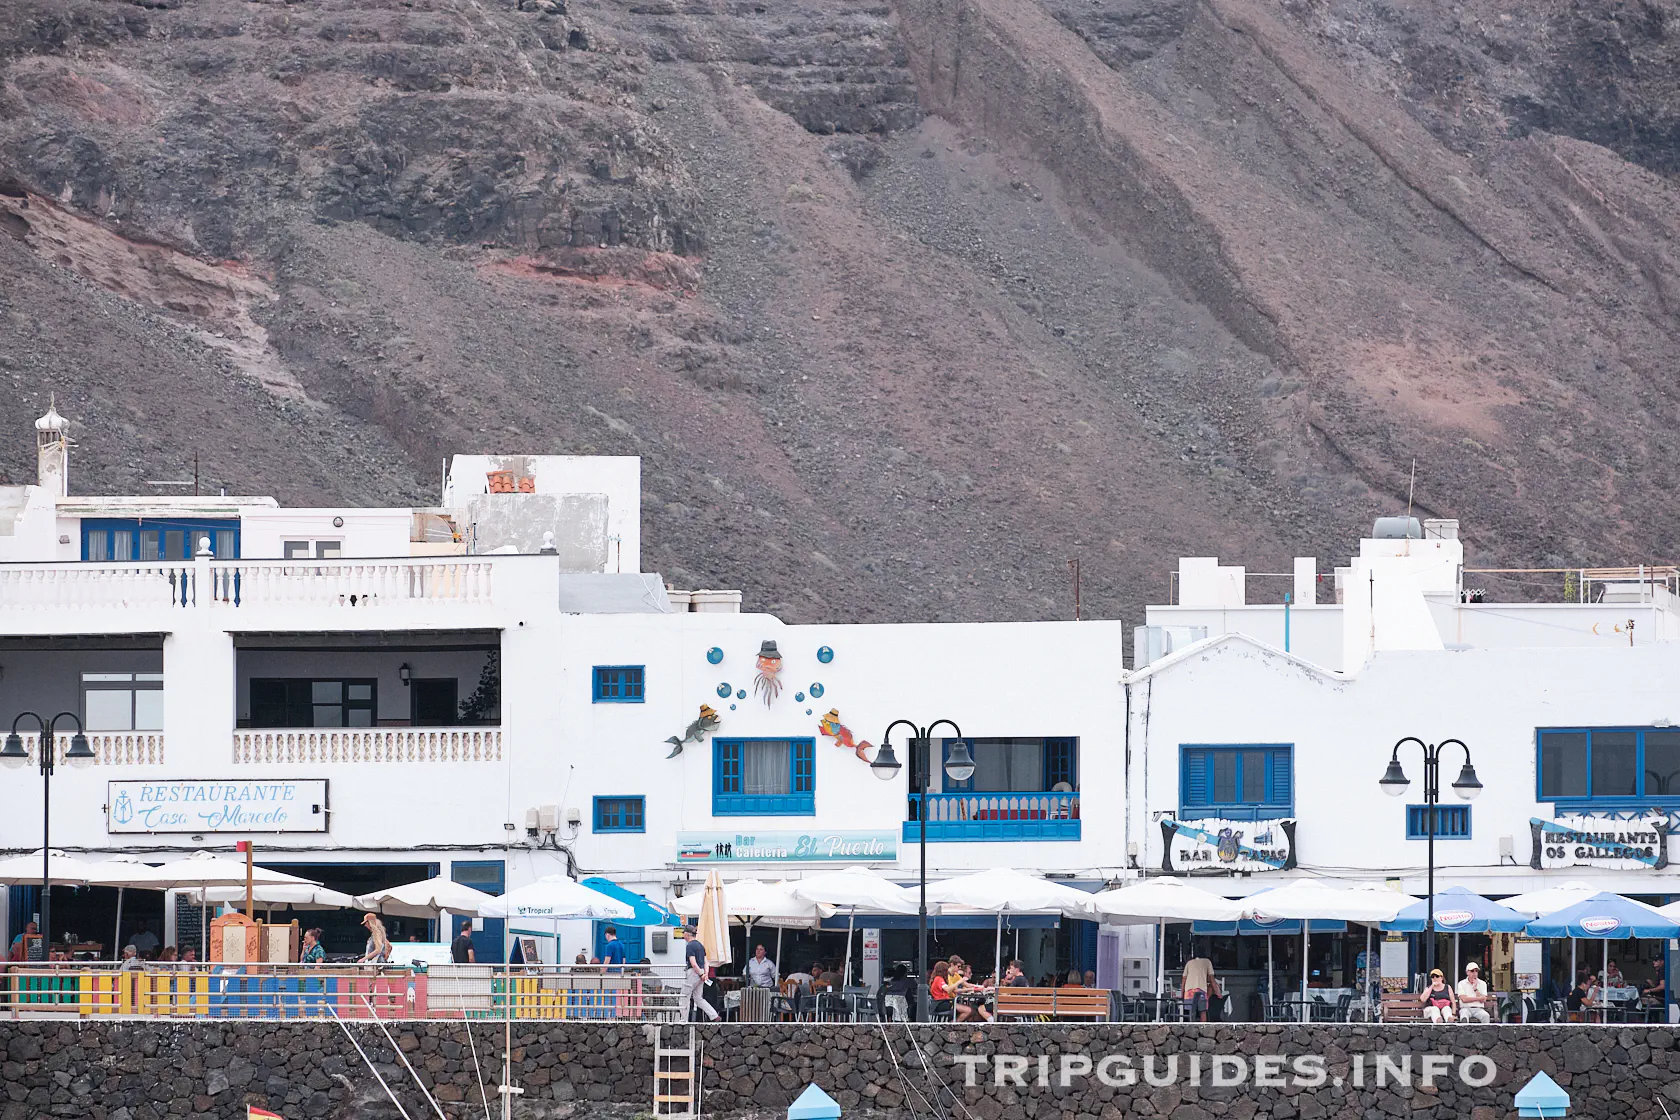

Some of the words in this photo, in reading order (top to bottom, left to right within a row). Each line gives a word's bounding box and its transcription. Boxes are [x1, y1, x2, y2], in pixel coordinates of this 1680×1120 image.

[139, 785, 296, 802] RESTAURANTE
[138, 804, 188, 828] Casa
[198, 804, 288, 828] Marcelo
[735, 834, 756, 847] Bar
[1545, 831, 1658, 844] RESTAURANTE
[795, 834, 818, 857] El
[823, 835, 885, 857] Puerto
[1180, 849, 1212, 861] BAR
[1239, 849, 1287, 861] TAPAS
[1546, 846, 1566, 859] OS
[1574, 846, 1654, 859] GALLEGOS
[527, 906, 553, 915] Tropical
